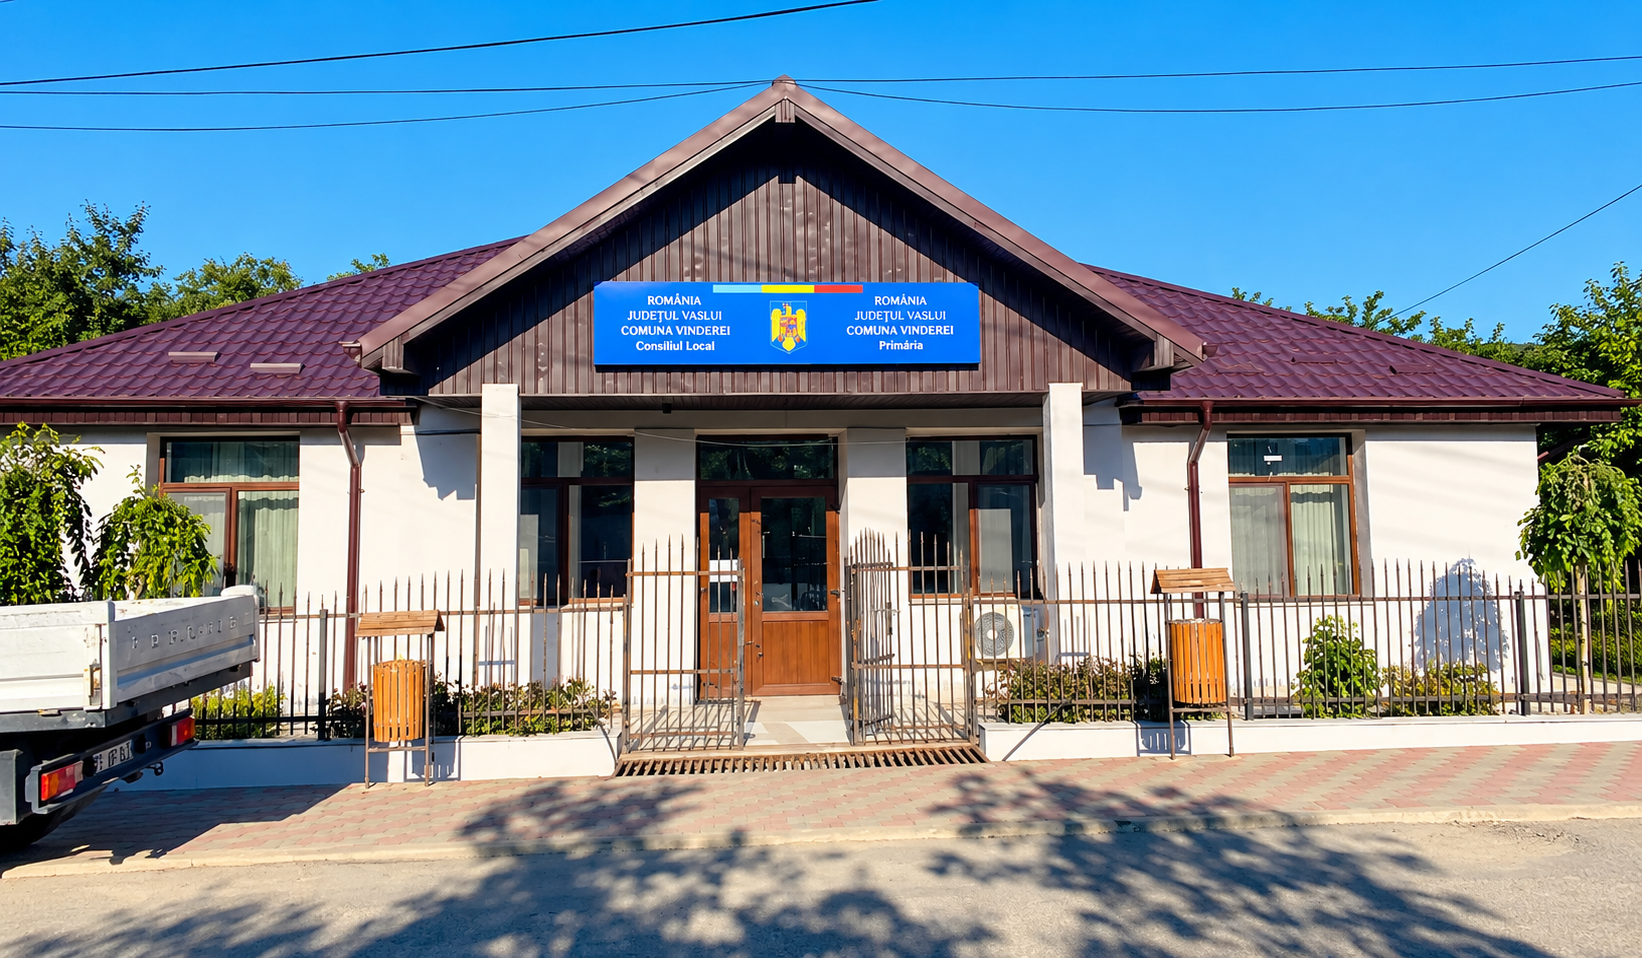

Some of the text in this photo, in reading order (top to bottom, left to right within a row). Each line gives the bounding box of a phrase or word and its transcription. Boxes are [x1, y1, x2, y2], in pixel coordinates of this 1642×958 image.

[647, 293, 702, 306] ROMÂNIA
[874, 294, 927, 306] ROMÂNIA
[682, 310, 722, 321] VASLUI
[907, 310, 946, 320] VASLUI
[621, 325, 731, 336] COMUNA VINDEREI
[846, 325, 954, 335] COMUNA VINDEREI
[635, 340, 715, 351] Consiliul Local
